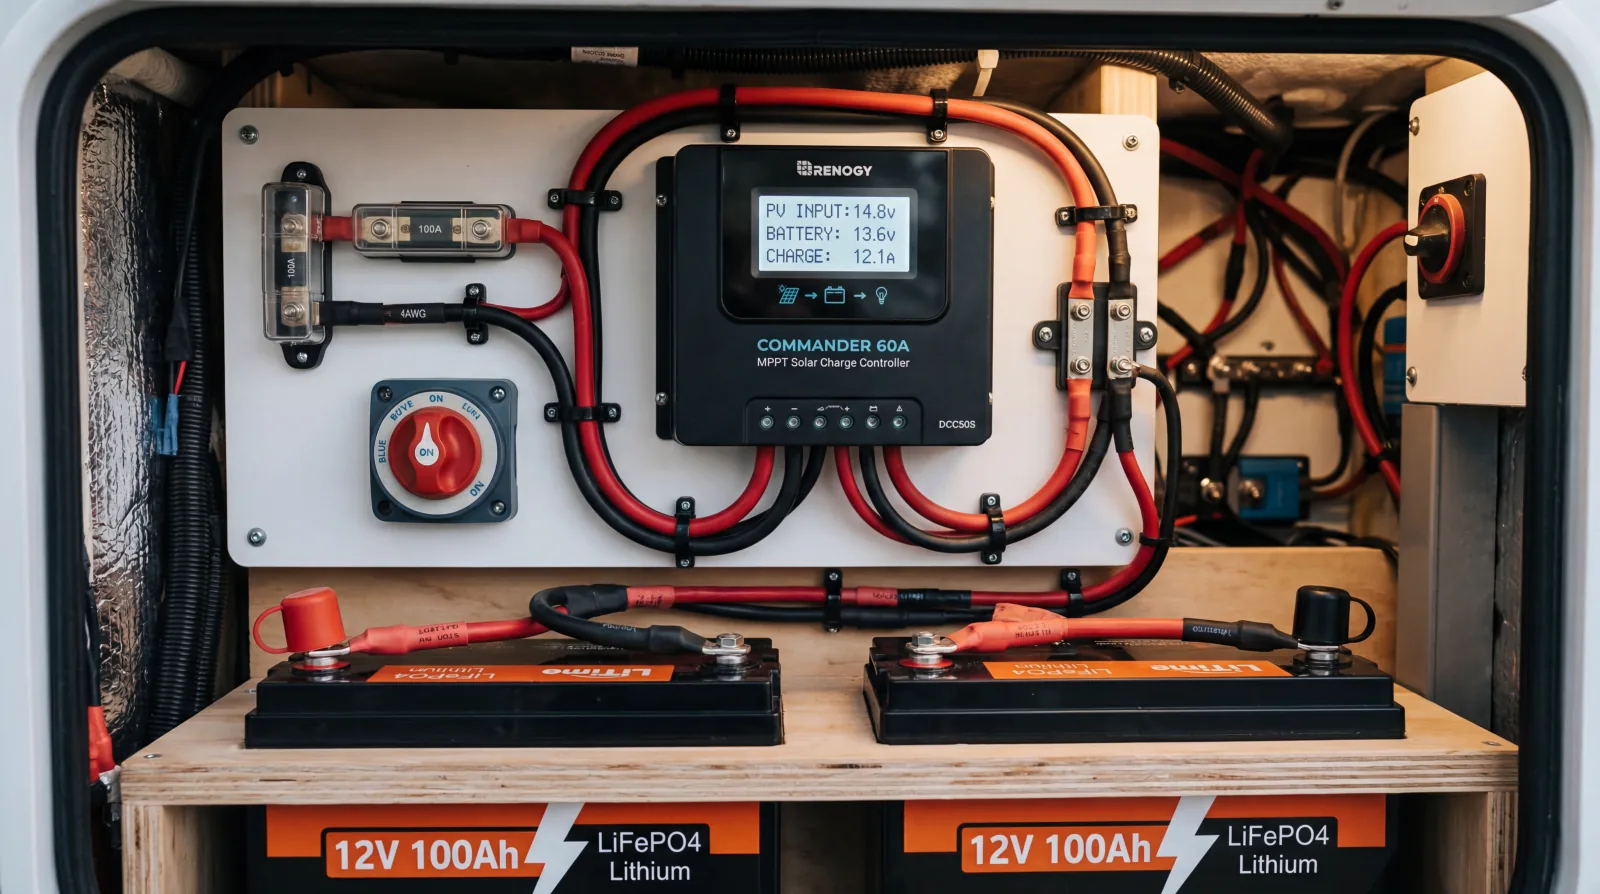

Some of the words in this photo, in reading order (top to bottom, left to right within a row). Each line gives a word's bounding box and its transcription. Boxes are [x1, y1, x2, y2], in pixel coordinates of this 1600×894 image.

[813, 165, 873, 177] RENOGY
[766, 203, 786, 218] PV
[418, 224, 443, 234] 100A
[766, 226, 840, 242] BATTERY:
[854, 226, 896, 242] 13.6v
[766, 248, 830, 264] CHARGE:
[854, 248, 896, 265] 12.1A
[287, 257, 296, 279] 100A
[400, 308, 427, 319] 4AWG
[757, 338, 871, 353] COMMANDER
[876, 339, 910, 353] 60A
[757, 357, 788, 368] MPPT
[791, 357, 818, 368] Solar
[820, 357, 857, 370] Charge
[859, 357, 910, 369] Controller
[429, 394, 443, 403] ON
[938, 420, 976, 430] DCC50S
[377, 439, 387, 464] BLUE
[419, 448, 434, 457] ON
[469, 480, 485, 497] ON
[1151, 663, 1264, 673] LiTime
[597, 831, 702, 854] LiFePO4
[1227, 823, 1330, 847] LiFePO4
[335, 839, 400, 870] 12V
[411, 839, 519, 870] 100Ah
[970, 833, 1034, 865] 12V
[1045, 832, 1151, 864] 100Ah
[609, 861, 691, 882] Lithium
[1238, 854, 1319, 875] Lithium
